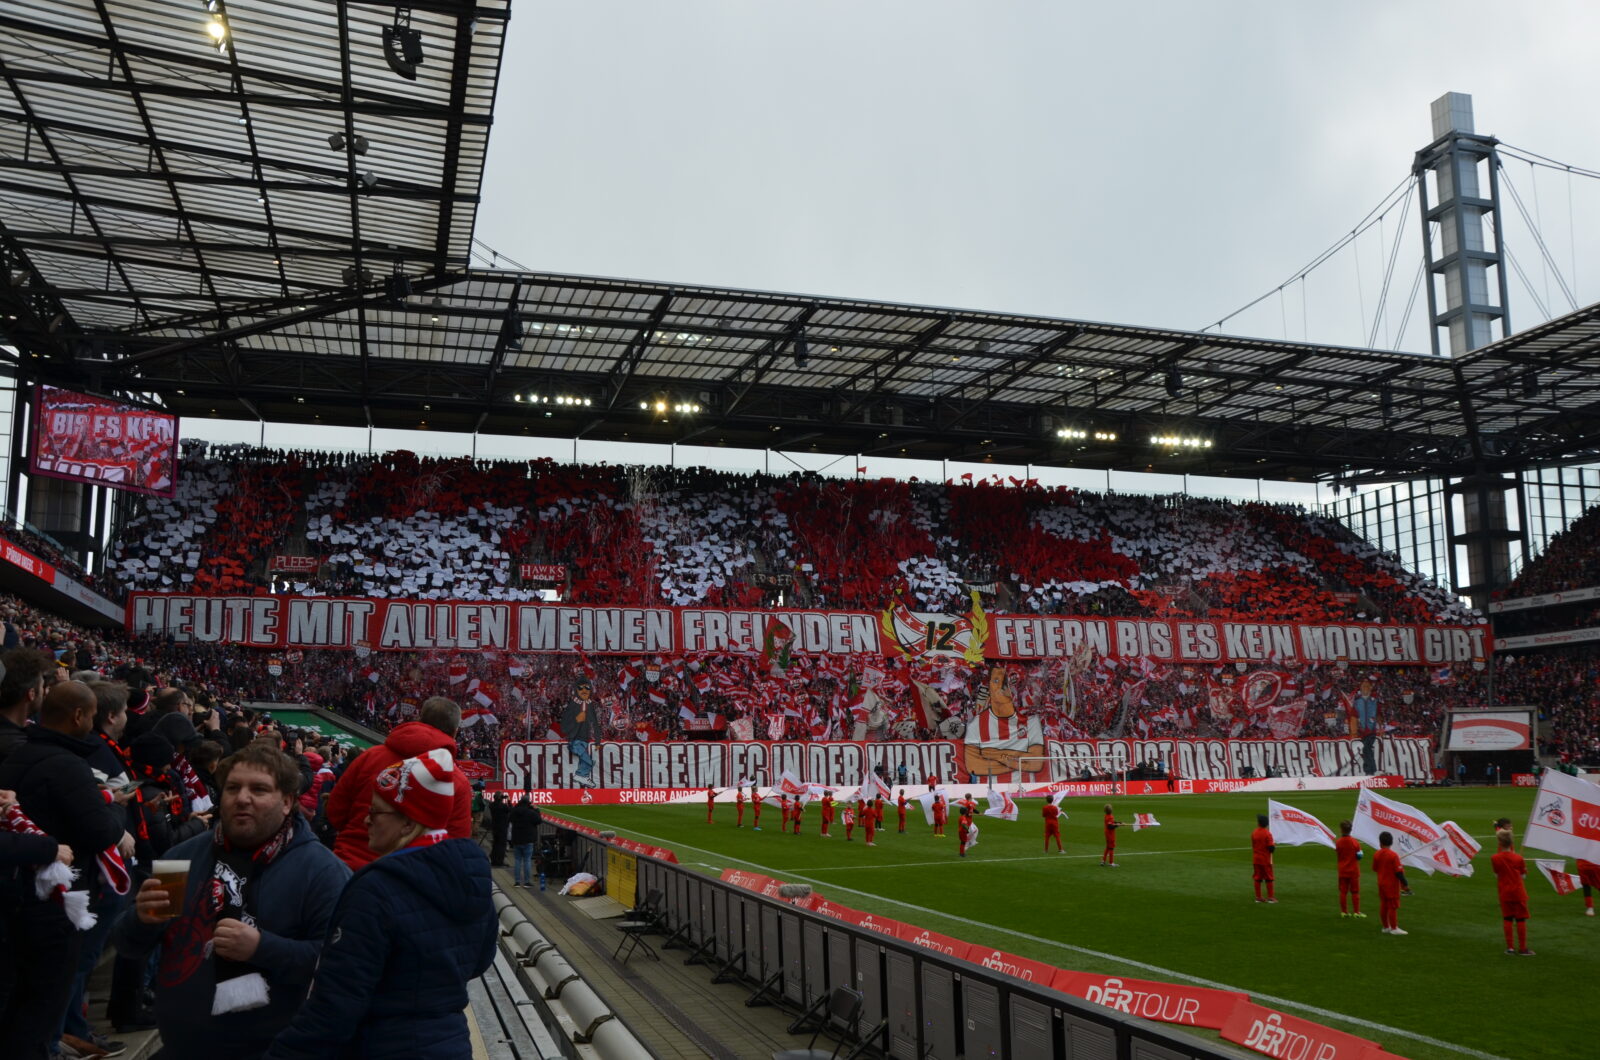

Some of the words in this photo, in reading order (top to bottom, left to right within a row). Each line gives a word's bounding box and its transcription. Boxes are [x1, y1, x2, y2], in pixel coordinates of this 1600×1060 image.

[94, 416, 121, 438] ES
[521, 565, 565, 577] HAWKS
[134, 598, 278, 644] HEUTE
[289, 600, 374, 647] MIT
[381, 603, 508, 650] ALLEN
[519, 606, 673, 652] MEINEN
[926, 621, 956, 651] 12
[997, 618, 1110, 659] FEIERN
[1118, 621, 1173, 660] BIS
[1179, 623, 1221, 661] ES
[1223, 623, 1297, 664] KEIN
[1299, 624, 1420, 662] MORGEN
[1423, 626, 1486, 663] GIBT
[589, 741, 646, 789] ICH
[650, 742, 727, 789] BEIM
[730, 742, 769, 788] FC
[770, 743, 804, 786] IN
[808, 743, 865, 787] DER
[867, 743, 956, 786] KURVE
[1048, 740, 1095, 783] DER
[1177, 740, 1228, 781] DAS
[1228, 740, 1316, 780] EINZIGE
[620, 788, 667, 803] SPÜRBAR
[1085, 979, 1200, 1024] DERTOUR
[1244, 1013, 1337, 1060] DERTOUR
